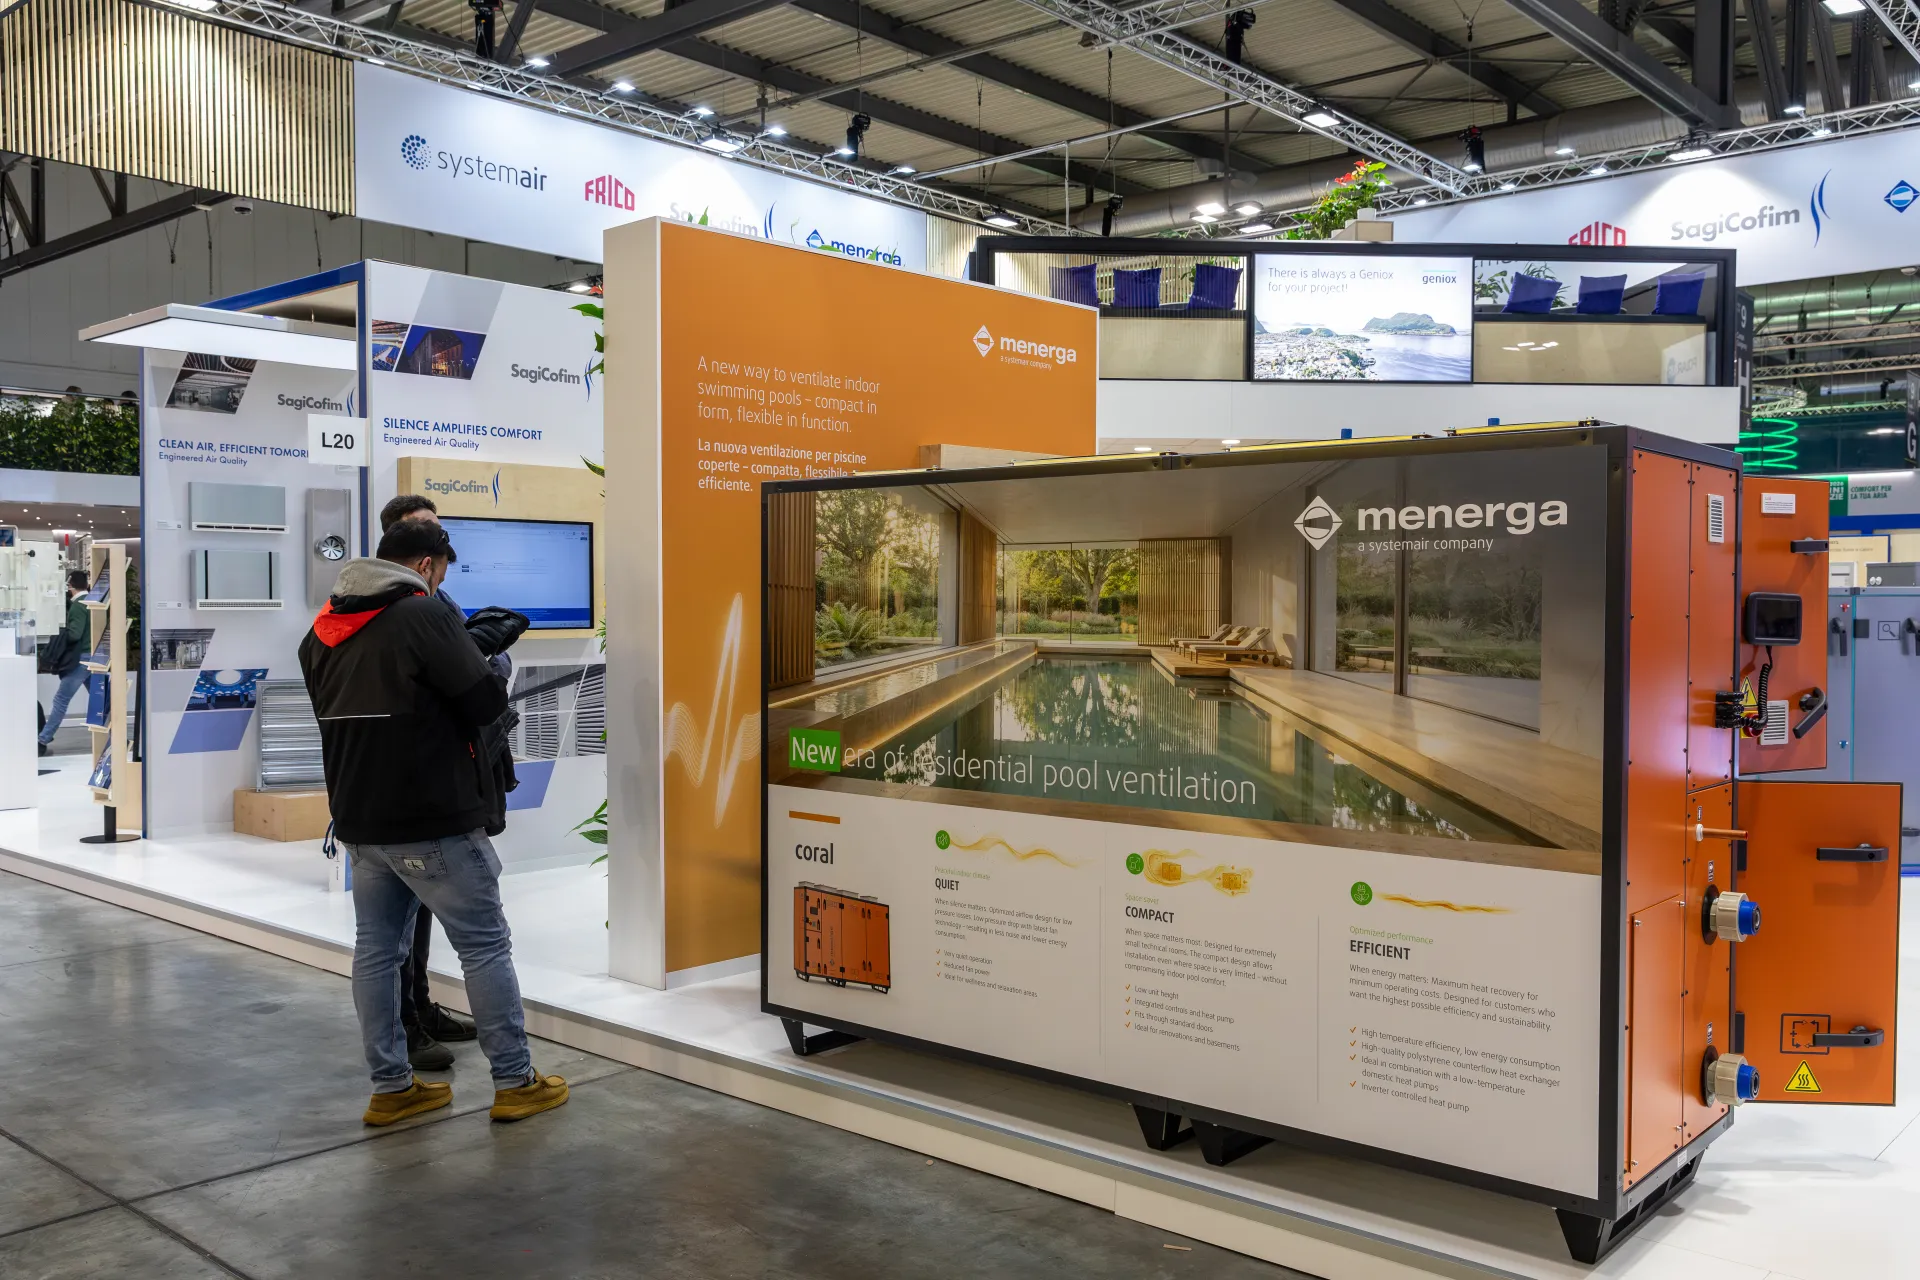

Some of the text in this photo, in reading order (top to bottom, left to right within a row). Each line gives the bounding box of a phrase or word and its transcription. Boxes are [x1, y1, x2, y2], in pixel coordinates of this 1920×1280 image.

[438, 147, 547, 193] systemair
[585, 175, 635, 212] FRICO
[1670, 205, 1800, 242] SagiCofim
[1268, 268, 1393, 280] There is always a Geniox
[1423, 274, 1456, 284] geniox
[1268, 282, 1348, 295] for your project!
[1741, 305, 1747, 328] 9
[1000, 336, 1076, 365] menerga
[511, 363, 581, 386] SagiCofim
[698, 356, 880, 393] A new way to ventilate indoor
[1030, 360, 1052, 371] company
[277, 393, 343, 415] SagiCofim
[698, 381, 764, 405] swimming
[770, 390, 801, 406] pools
[815, 396, 863, 413] compact
[868, 400, 877, 414] in
[383, 417, 542, 440] SILENCE AMPLIFIES COMFORT
[698, 402, 852, 432] form, flexible in function.
[159, 439, 308, 458] CLEAN AIR, EFFICIENT TOMOR
[322, 432, 354, 449] L20
[384, 433, 479, 451] Engineered Air Quality
[698, 438, 867, 464] La nuova ventilazione per piscine
[1908, 422, 1916, 459] G
[159, 452, 247, 466] Engineered Air Quality
[698, 459, 739, 474] coperte
[751, 463, 802, 478] compatta,
[424, 478, 488, 495] SagiCofim
[698, 476, 753, 492] efficiente.
[1358, 500, 1568, 535] menerga
[1358, 537, 1494, 553] a systemair company
[792, 736, 1258, 805] New era of residential pool ventilation
[796, 843, 834, 864] coral
[935, 878, 959, 891] QUIET
[1125, 905, 1174, 923] COMPACT
[1125, 928, 1142, 936] When
[1143, 931, 1159, 940] space
[1162, 933, 1184, 944] matters
[1205, 940, 1232, 952] Designed
[1234, 944, 1243, 952] for
[1245, 948, 1277, 960] extremely
[1350, 926, 1433, 945] Optimized performance
[1125, 940, 1140, 948] small
[1142, 942, 1167, 952] technical
[1190, 950, 1201, 958] The
[1203, 952, 1229, 963] compact
[1231, 957, 1250, 967] design
[1252, 961, 1272, 971] allows
[1350, 940, 1410, 960] EFFICIENT
[1350, 964, 1370, 974] When
[1372, 969, 1397, 979] energy
[1431, 977, 1469, 990] Maximum
[1471, 984, 1488, 994] heat
[1491, 987, 1524, 1000] recovery
[1527, 991, 1538, 1001] for
[1350, 977, 1556, 1018] minimum operating costs. Designed for customers who
[1350, 991, 1551, 1032] want the highest possible efficiency and sustainability.
[1362, 1028, 1560, 1072] High temperature efficiency, low energy consumption
[1362, 1042, 1560, 1088] High-quality polystyrene counterflow heat exchanger
[1362, 1056, 1379, 1066] Ideal
[1381, 1059, 1386, 1068] in
[1389, 1061, 1432, 1077] combination
[1434, 1071, 1450, 1081] with
[1460, 1075, 1525, 1095] low-temperature
[1362, 1069, 1439, 1092] domestic heat pumps
[1362, 1083, 1469, 1113] Inverter controlled heat pump
